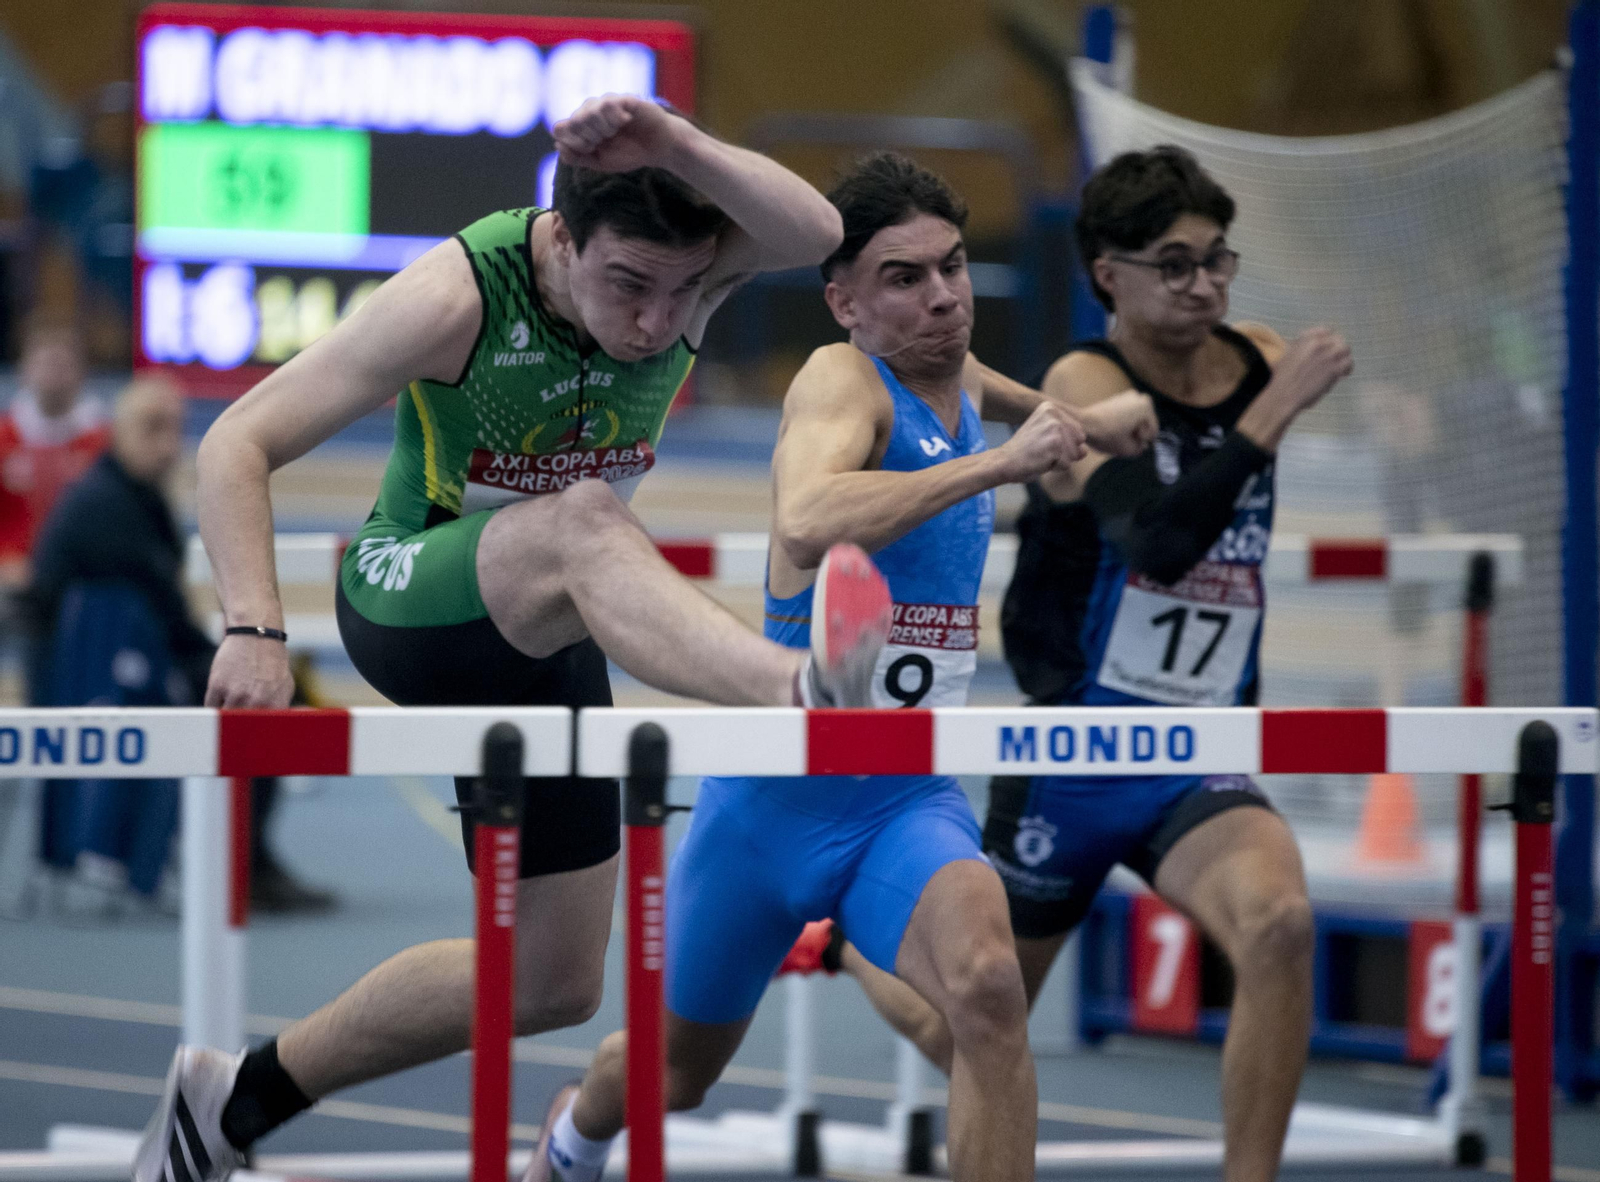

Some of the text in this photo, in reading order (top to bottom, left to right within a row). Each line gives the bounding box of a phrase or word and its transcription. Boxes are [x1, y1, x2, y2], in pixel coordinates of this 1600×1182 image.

[493, 352, 546, 367] VIATOR
[539, 371, 616, 403] LUCUS
[490, 447, 646, 472] XXI COPA ABS
[904, 605, 949, 626] COPA
[889, 625, 944, 646] RENSE
[1152, 606, 1232, 678] 17
[884, 653, 934, 709] 9
[0, 727, 146, 765] ONDO
[999, 724, 1196, 763] MONDO
